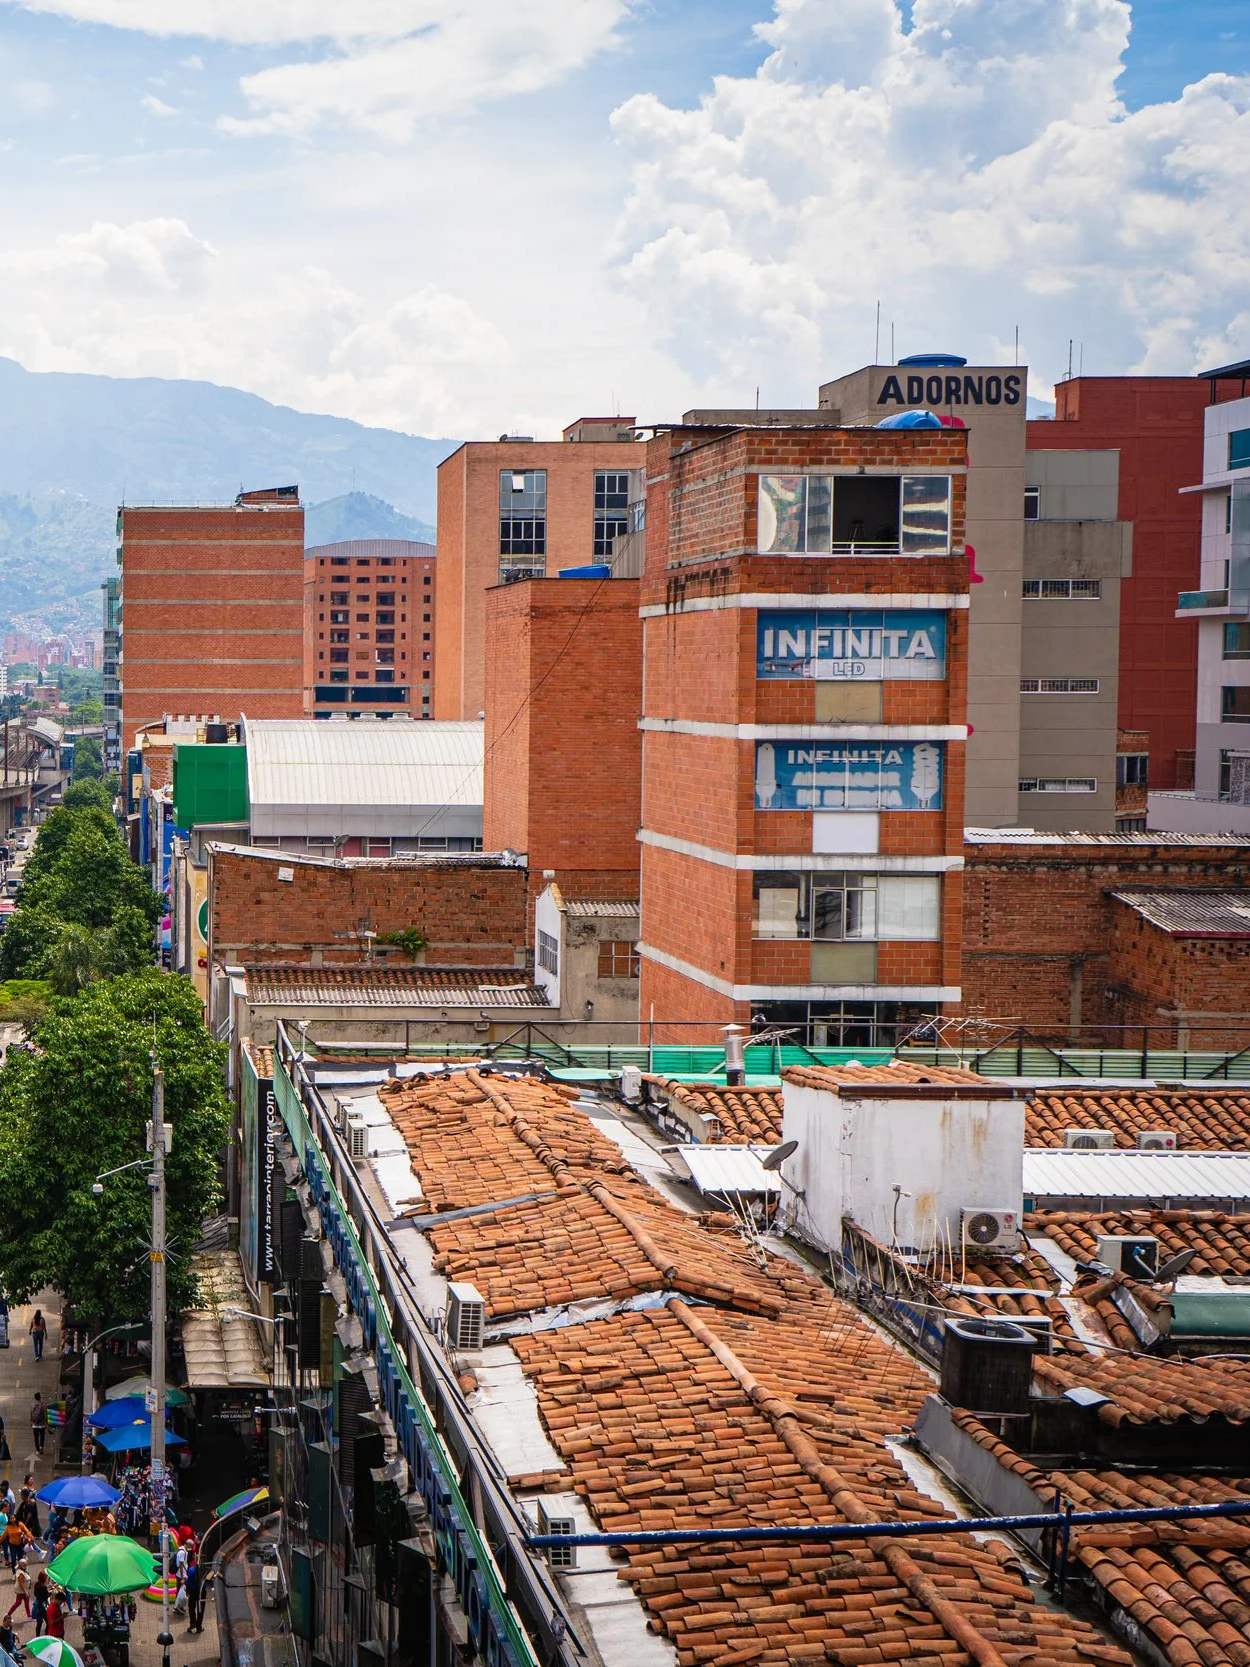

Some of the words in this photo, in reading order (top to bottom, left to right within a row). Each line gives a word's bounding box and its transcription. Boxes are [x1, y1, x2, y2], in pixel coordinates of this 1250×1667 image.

[876, 374, 1021, 406] ADORNOS
[763, 628, 937, 659] INFINITA
[832, 661, 866, 676] LED
[787, 749, 904, 765] INFINITA
